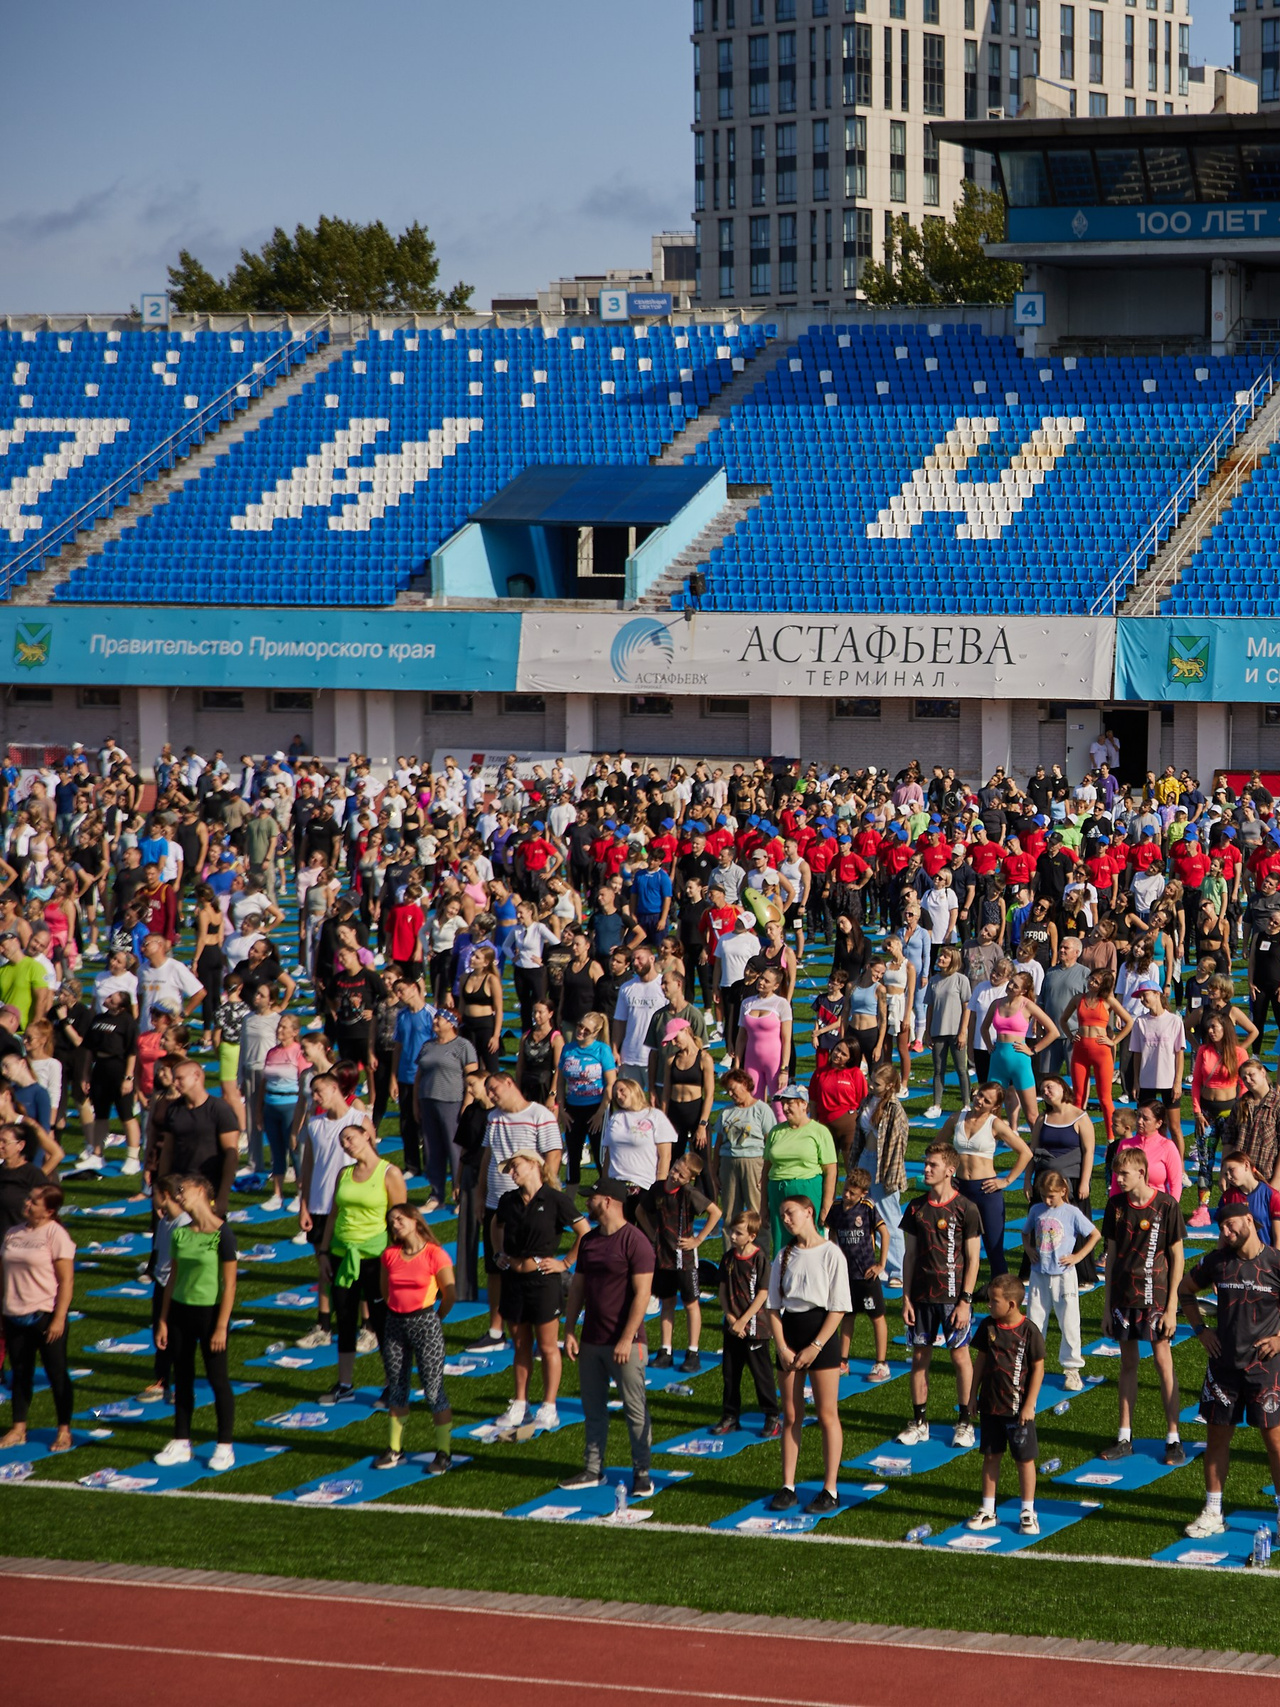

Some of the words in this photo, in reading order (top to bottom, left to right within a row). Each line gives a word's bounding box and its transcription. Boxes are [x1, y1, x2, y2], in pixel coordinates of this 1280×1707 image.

[1137, 211, 1191, 234] 100
[1201, 209, 1267, 233] ЛЕТ
[150, 302, 161, 317] 2
[608, 297, 621, 313] 3
[1021, 301, 1037, 317] 4
[90, 633, 243, 659] Правительство
[250, 636, 383, 661] Приморского
[388, 643, 436, 663] края
[737, 624, 1017, 666] АСТАФЬЕВА
[806, 670, 945, 688] ТЕРМИНАЛ
[1245, 669, 1258, 683] и
[1145, 1222, 1160, 1268] FIGHTING
[947, 1271, 956, 1298] PRIDE
[1144, 1277, 1153, 1305] PRIDE
[1217, 1282, 1245, 1290] FIGHTING
[1252, 1285, 1273, 1293] PRIDE
